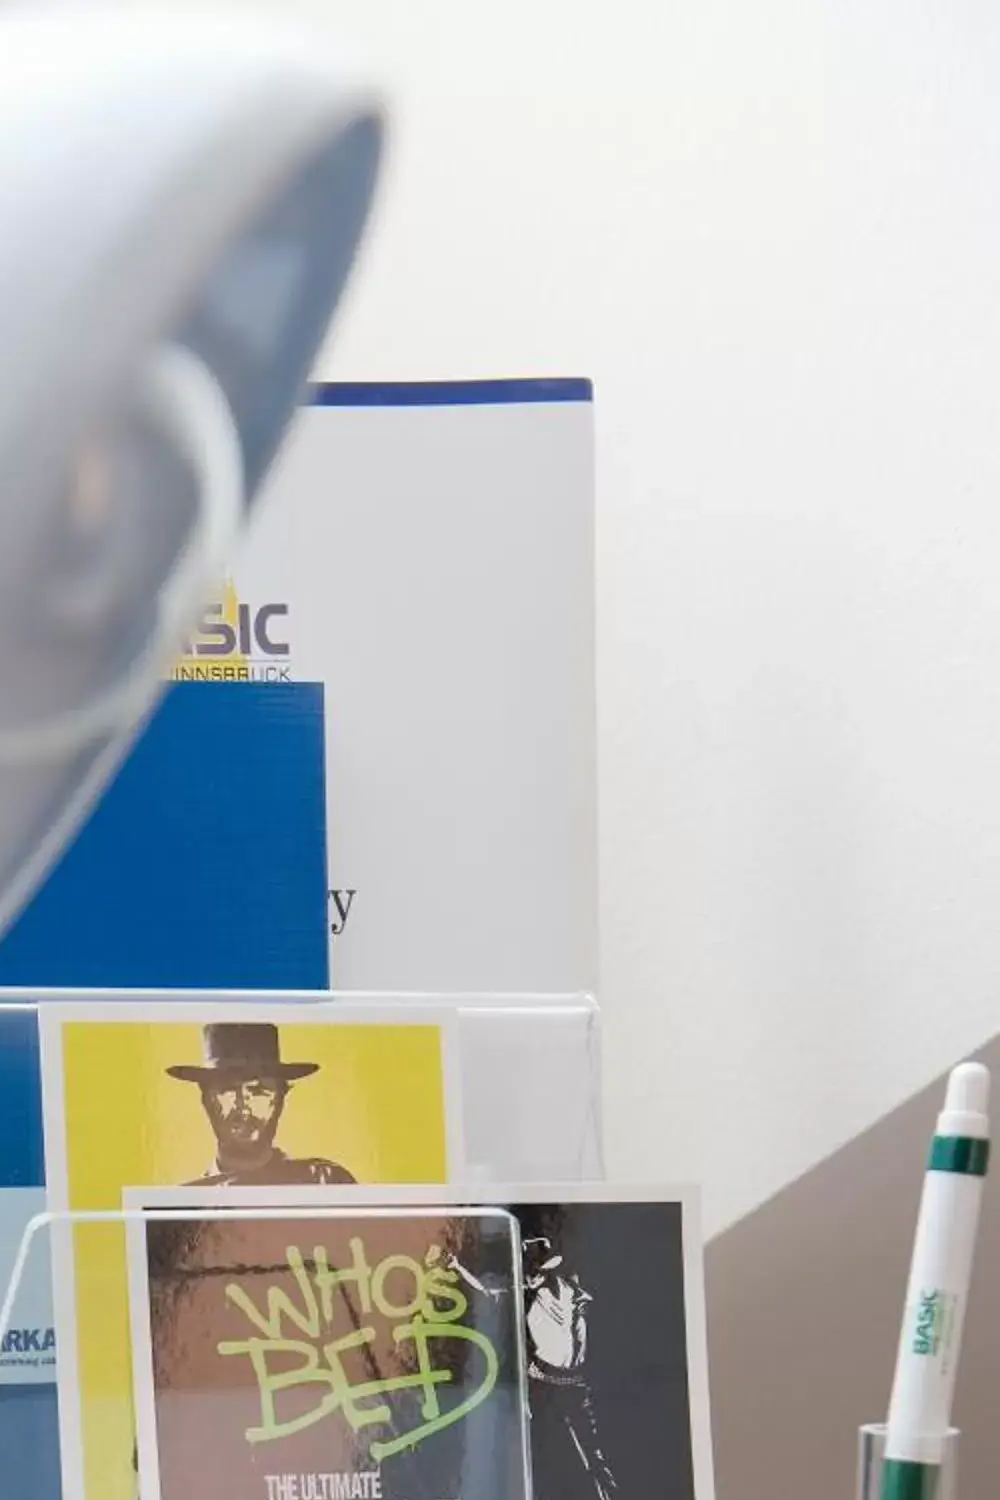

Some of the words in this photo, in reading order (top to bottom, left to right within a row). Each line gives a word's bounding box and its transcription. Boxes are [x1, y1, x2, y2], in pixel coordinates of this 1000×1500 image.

[328, 890, 357, 934] y
[911, 1287, 938, 1356] BASIC
[217, 1314, 499, 1462] BED
[264, 1474, 298, 1500] THE
[301, 1470, 383, 1499] ULTIMATE
